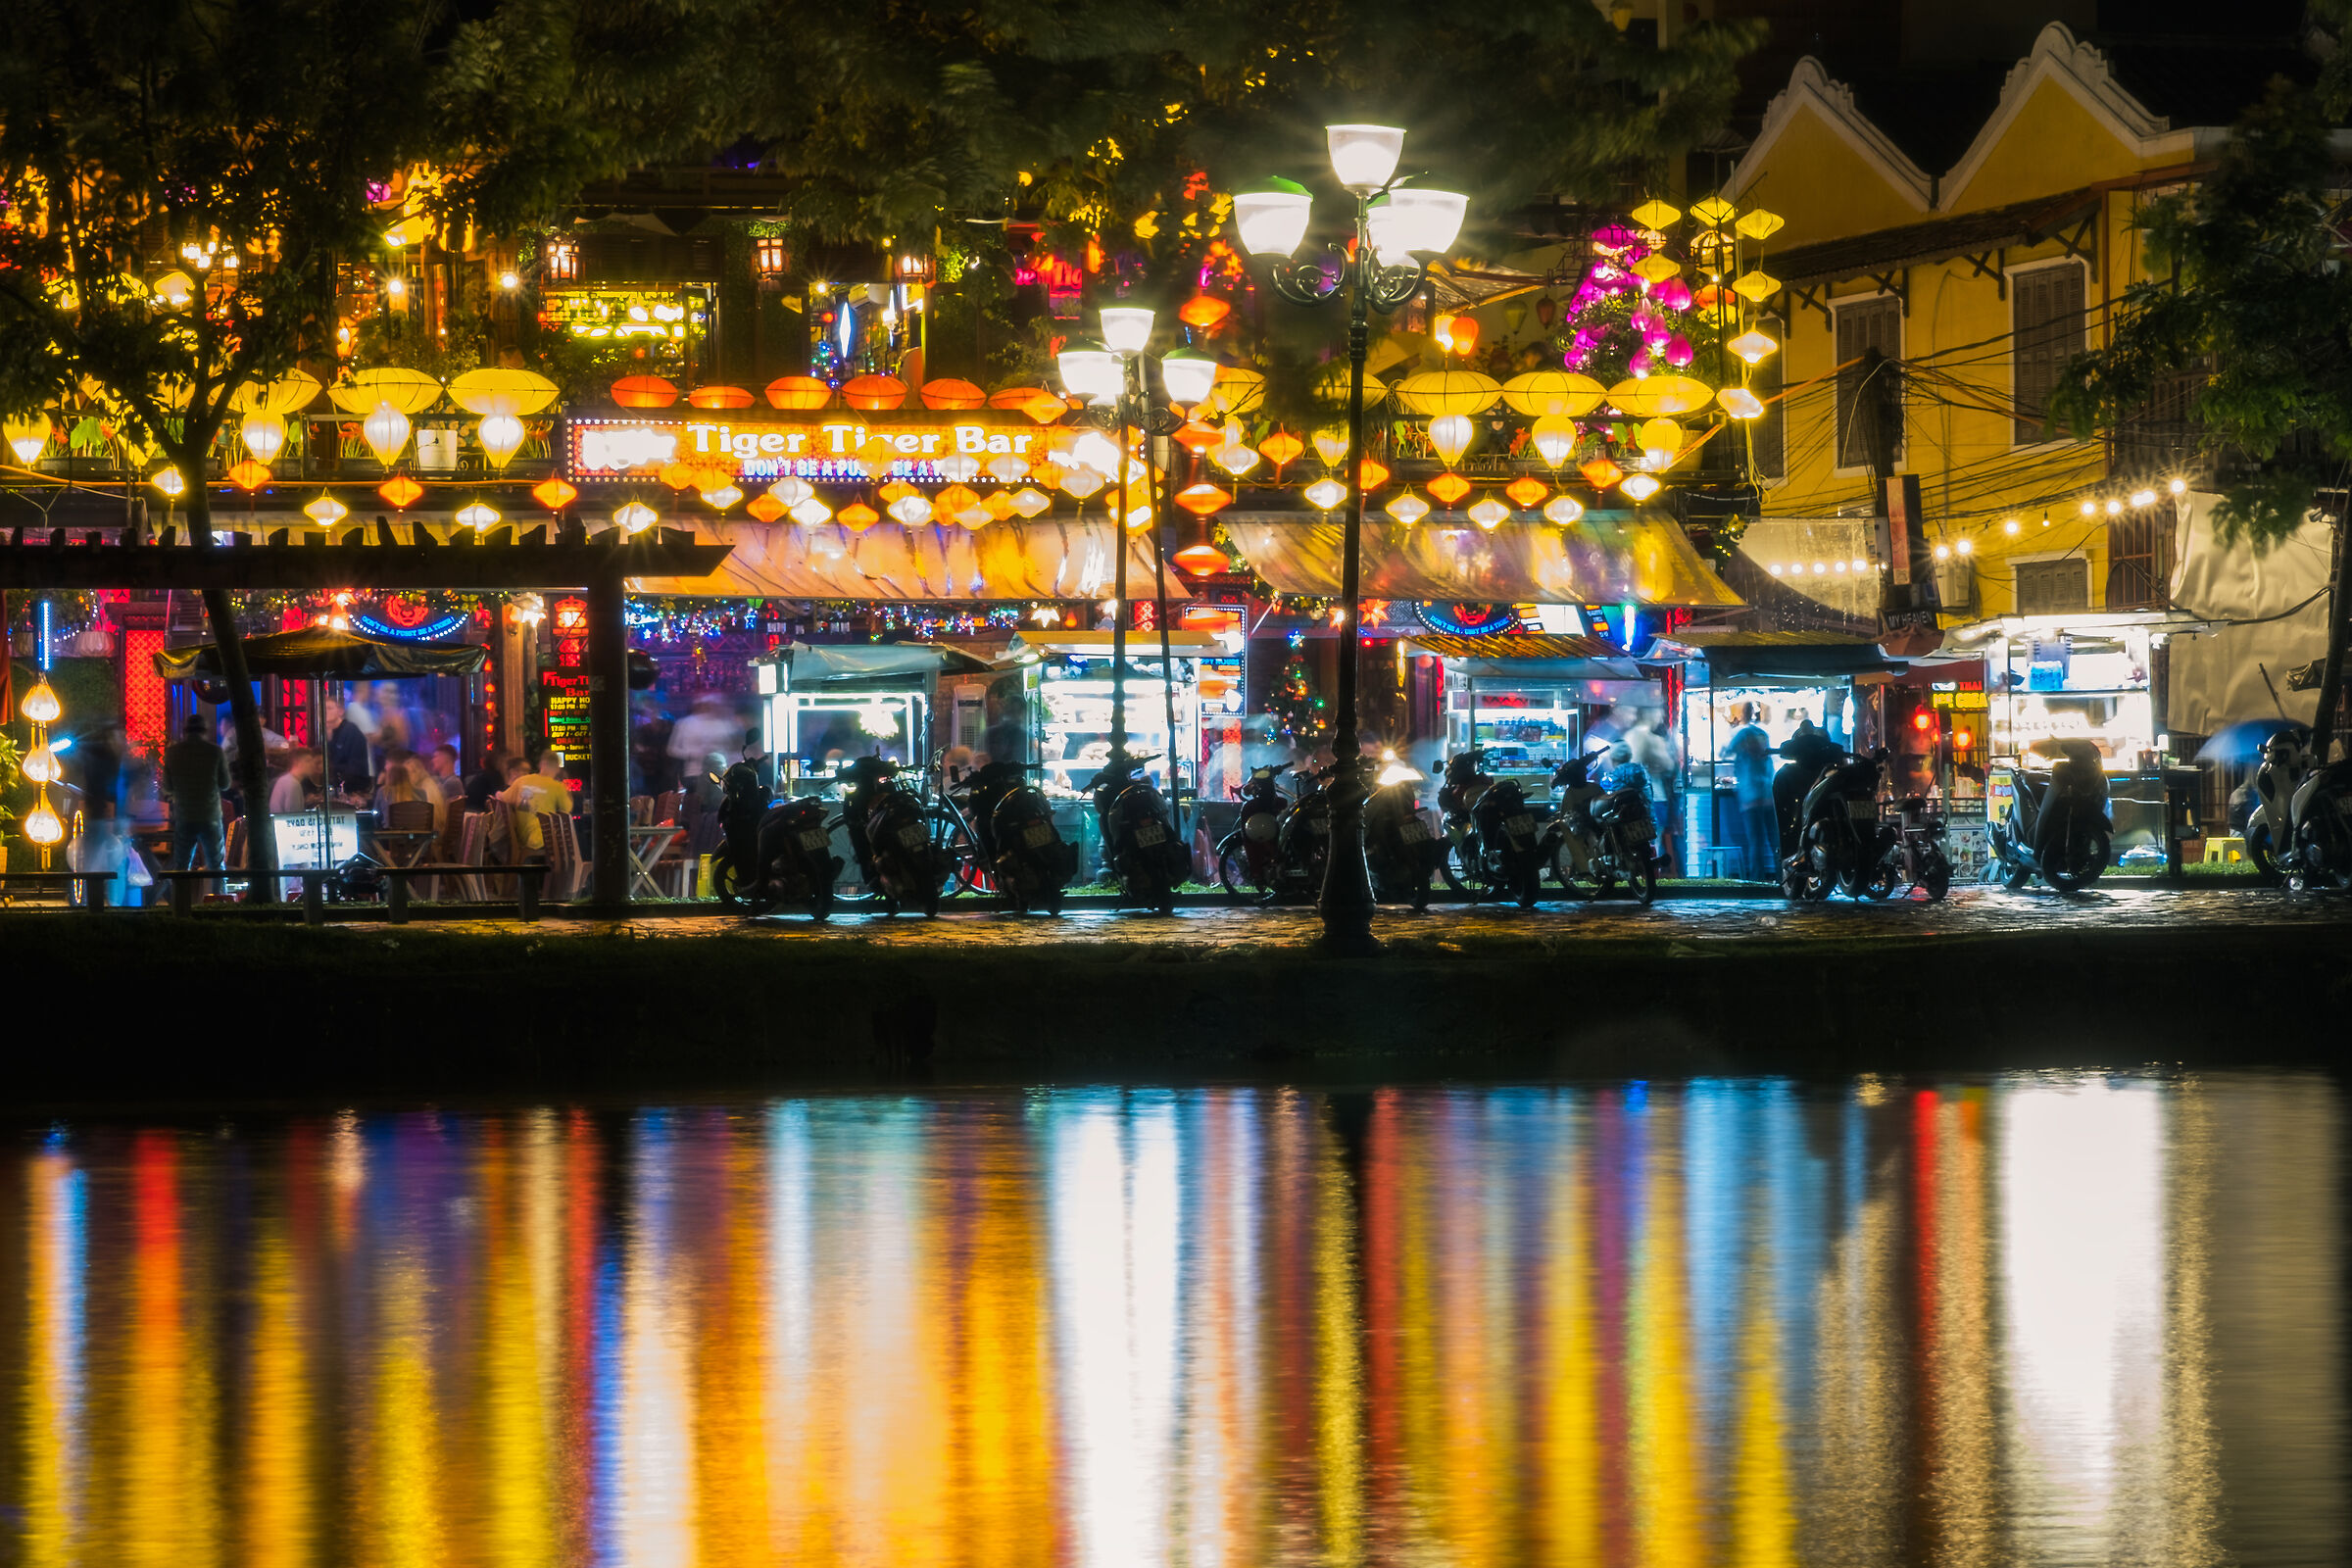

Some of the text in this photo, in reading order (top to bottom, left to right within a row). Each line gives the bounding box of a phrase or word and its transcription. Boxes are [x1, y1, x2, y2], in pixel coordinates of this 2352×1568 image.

[687, 424, 806, 459] Tiger
[955, 426, 1032, 454] Bar
[743, 456, 792, 476] DON'T
[796, 460, 818, 476] BE
[821, 459, 834, 476] A
[1901, 611, 1933, 625] HEAVEN
[549, 675, 577, 688] Tiger
[1959, 681, 1983, 691] THAI
